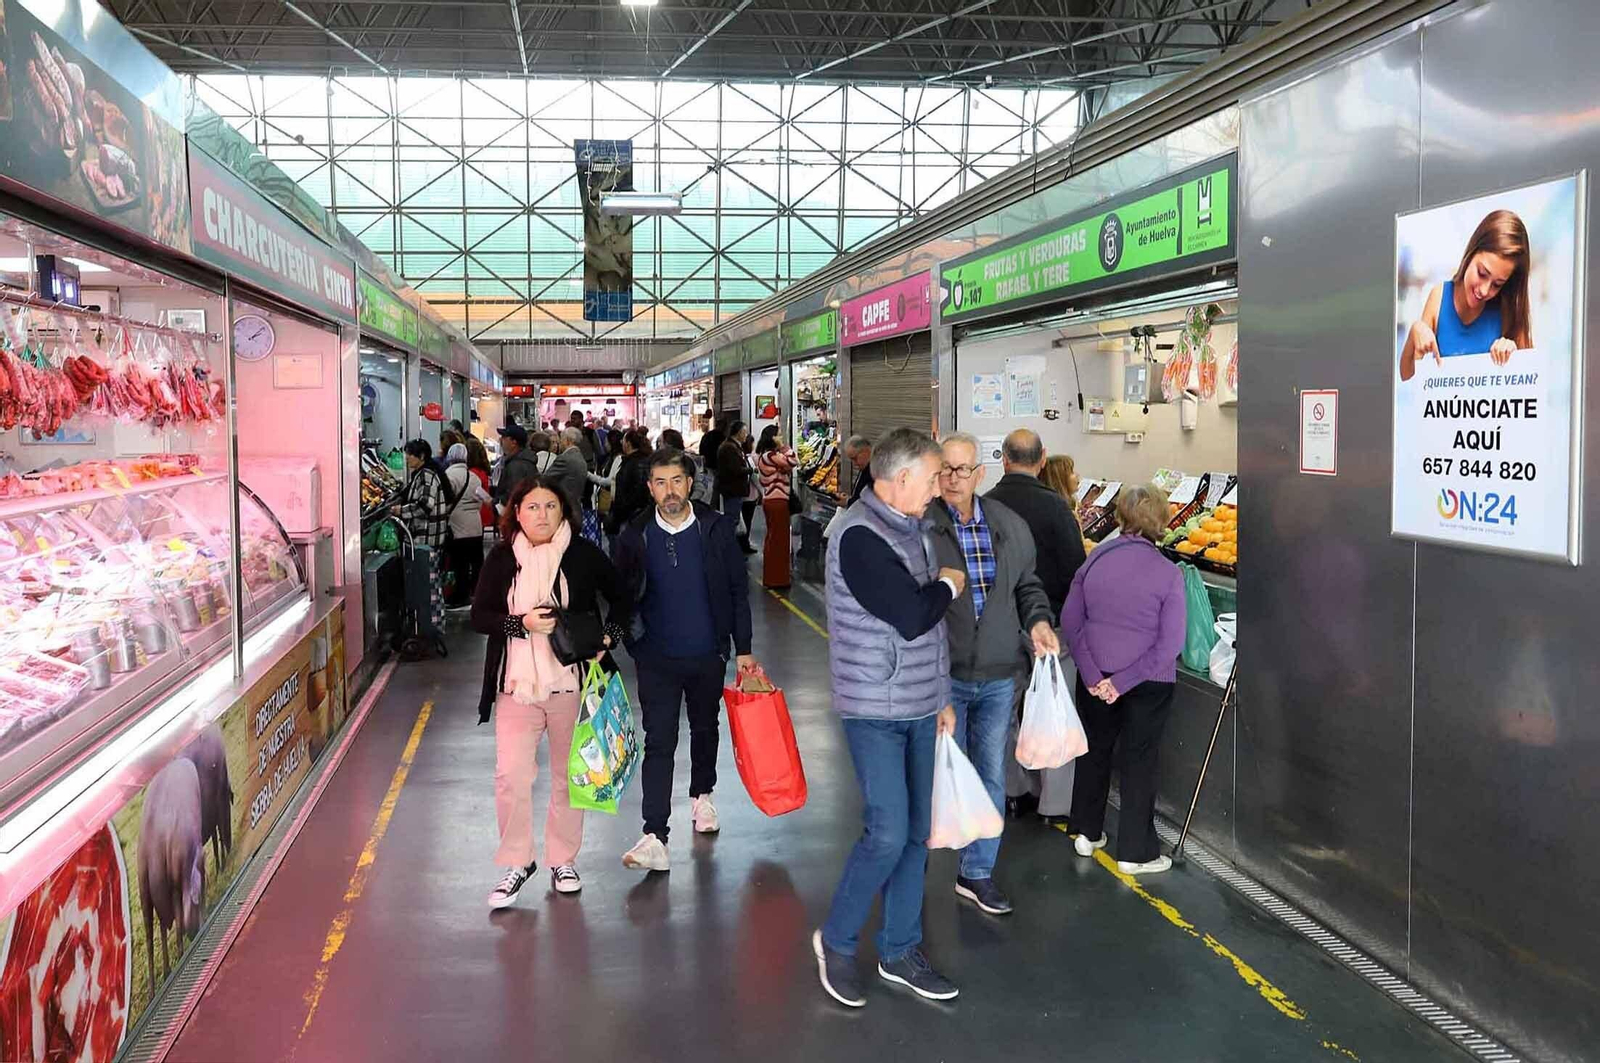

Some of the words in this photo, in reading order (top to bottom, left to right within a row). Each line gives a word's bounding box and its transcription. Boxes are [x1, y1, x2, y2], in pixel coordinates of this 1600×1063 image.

[1125, 208, 1176, 237] Ayuntamiento
[1138, 235, 1148, 246] de
[1149, 226, 1176, 245] Huelva
[203, 186, 319, 294] CHARCUTERÍA
[323, 265, 353, 310] CINTA
[984, 253, 1018, 280] FRUTAS
[1019, 249, 1028, 269] Y
[1028, 229, 1087, 267] VERDURAS
[996, 272, 1031, 299] RAFAEL
[1033, 269, 1041, 290] Y
[1042, 261, 1070, 287] TERE
[969, 286, 982, 305] 147
[862, 299, 890, 327] CAPFE
[1423, 377, 1465, 391] ¿QUIERES
[1467, 375, 1487, 388] QUE
[1490, 375, 1502, 386] TE
[1504, 372, 1539, 386] VEAN?
[1423, 394, 1538, 419] ANÚNCIATE
[1453, 425, 1502, 451] AQUÍ
[1422, 457, 1453, 475] 657
[1459, 459, 1493, 478] 844
[1499, 461, 1536, 481] 820
[1437, 488, 1517, 526] ON:24
[255, 673, 299, 739] DIRECTAMENTE
[258, 746, 267, 777] DE
[267, 712, 296, 759] NUESTRA
[250, 779, 272, 829] SIERRA
[273, 766, 283, 796] DE
